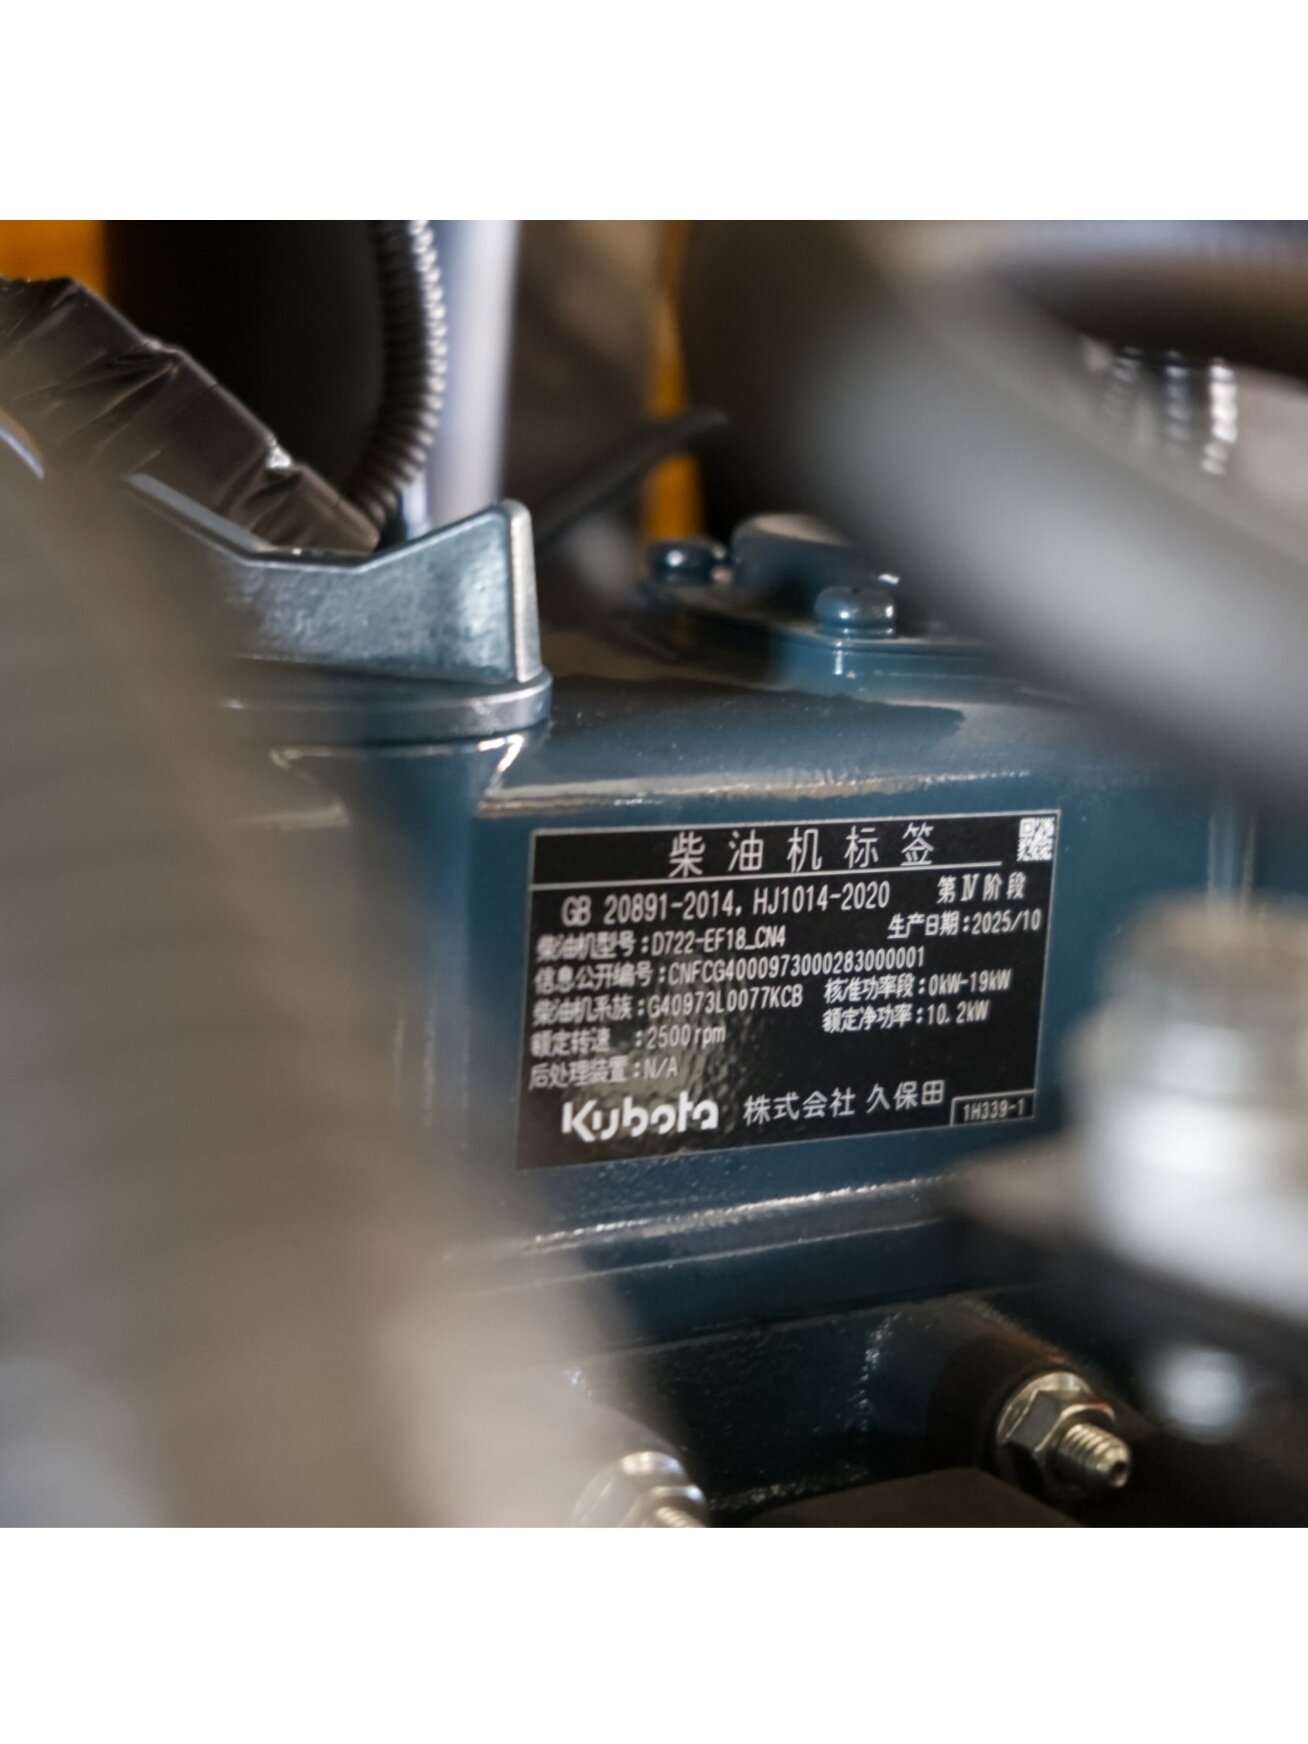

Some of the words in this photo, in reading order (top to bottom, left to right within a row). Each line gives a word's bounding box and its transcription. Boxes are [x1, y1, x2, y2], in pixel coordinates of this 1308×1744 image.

[668, 822, 935, 878] 柴油机标签
[561, 894, 592, 927] GB
[752, 880, 891, 916] HJ1014-2020
[561, 1090, 719, 1143] Kubota
[743, 1087, 856, 1126] 株式会社
[866, 1079, 946, 1115] 久保田
[962, 1098, 1025, 1122] 1H339-1
